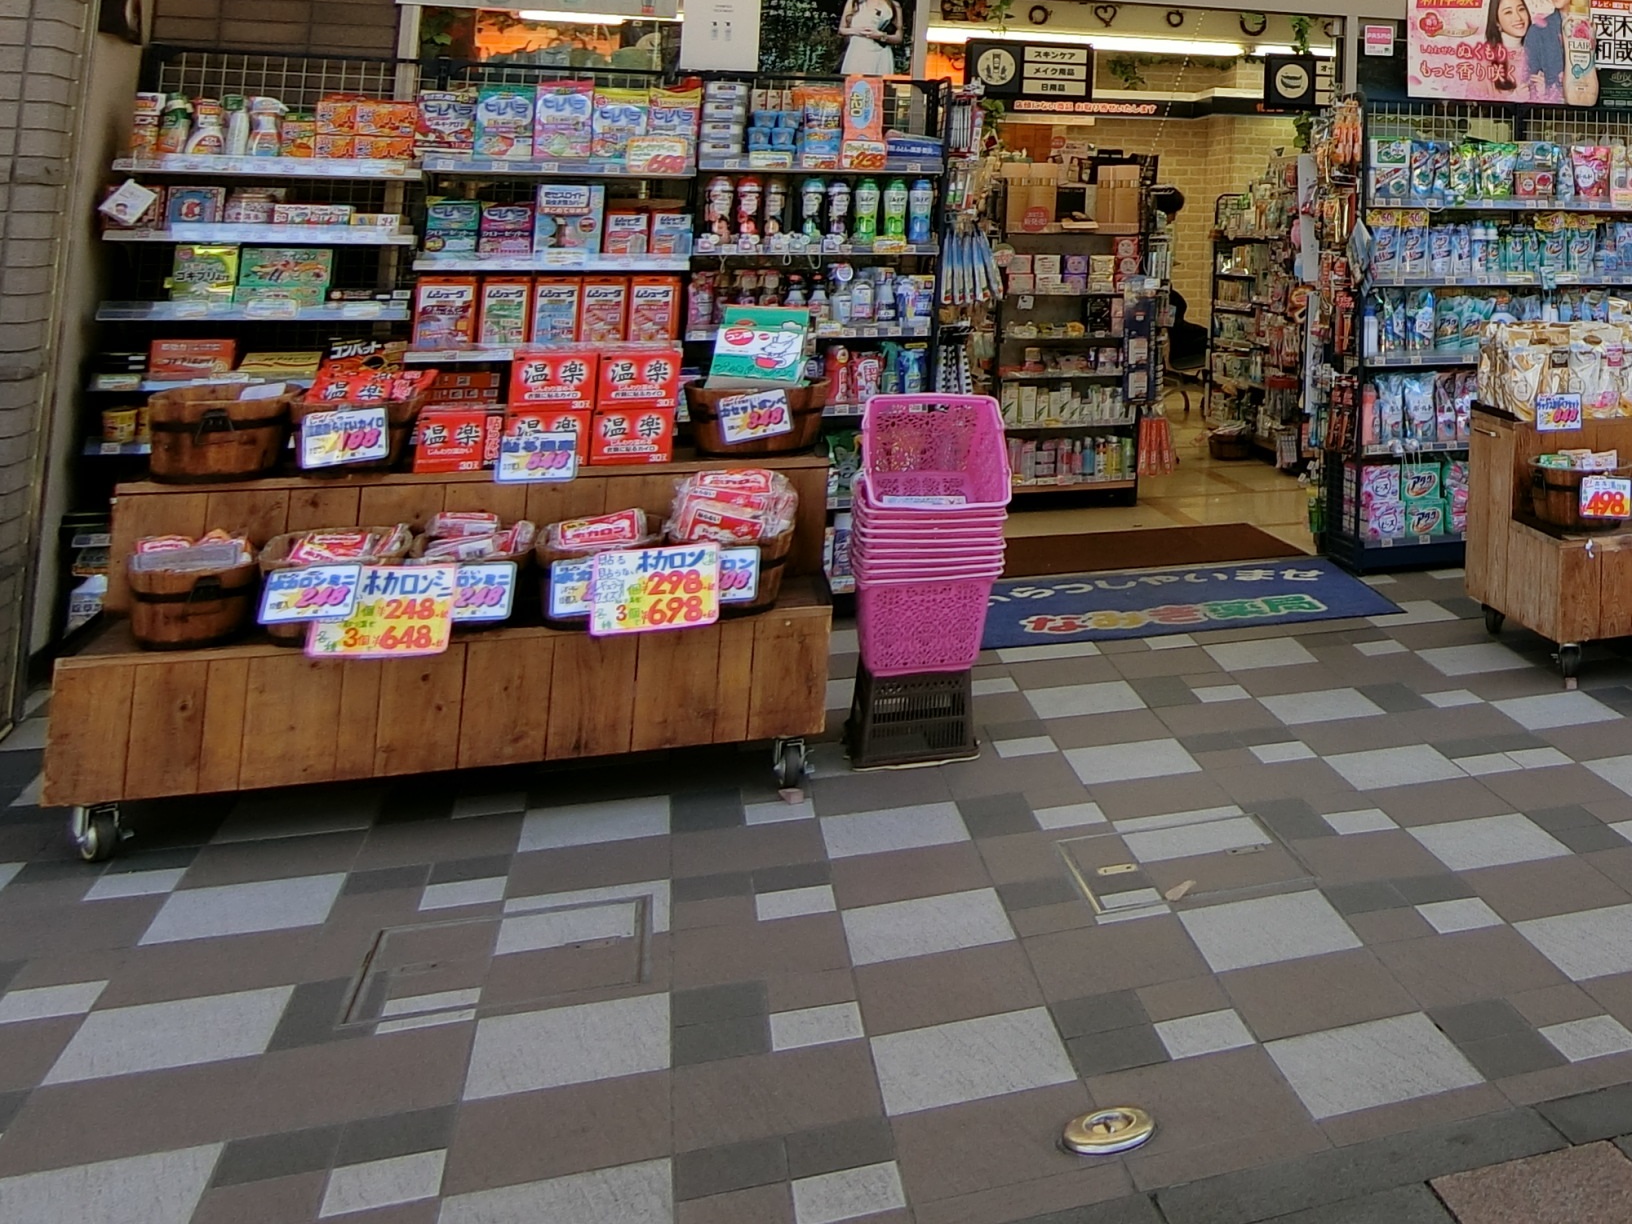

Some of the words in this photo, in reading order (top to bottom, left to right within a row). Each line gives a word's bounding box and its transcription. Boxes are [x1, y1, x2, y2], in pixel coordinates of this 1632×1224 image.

[1033, 50, 1076, 60] スキンケア
[1033, 67, 1075, 76] メイク用品
[1420, 61, 1516, 83] もっと香り咲く
[1041, 83, 1066, 92] 日用品
[523, 361, 584, 384] 温楽
[610, 360, 669, 383] 温楽
[421, 422, 482, 446] 温楽
[603, 414, 668, 438] 温楽
[1586, 490, 1625, 516] 498
[294, 586, 351, 609] 248
[1018, 593, 1329, 634] なみき薬局
